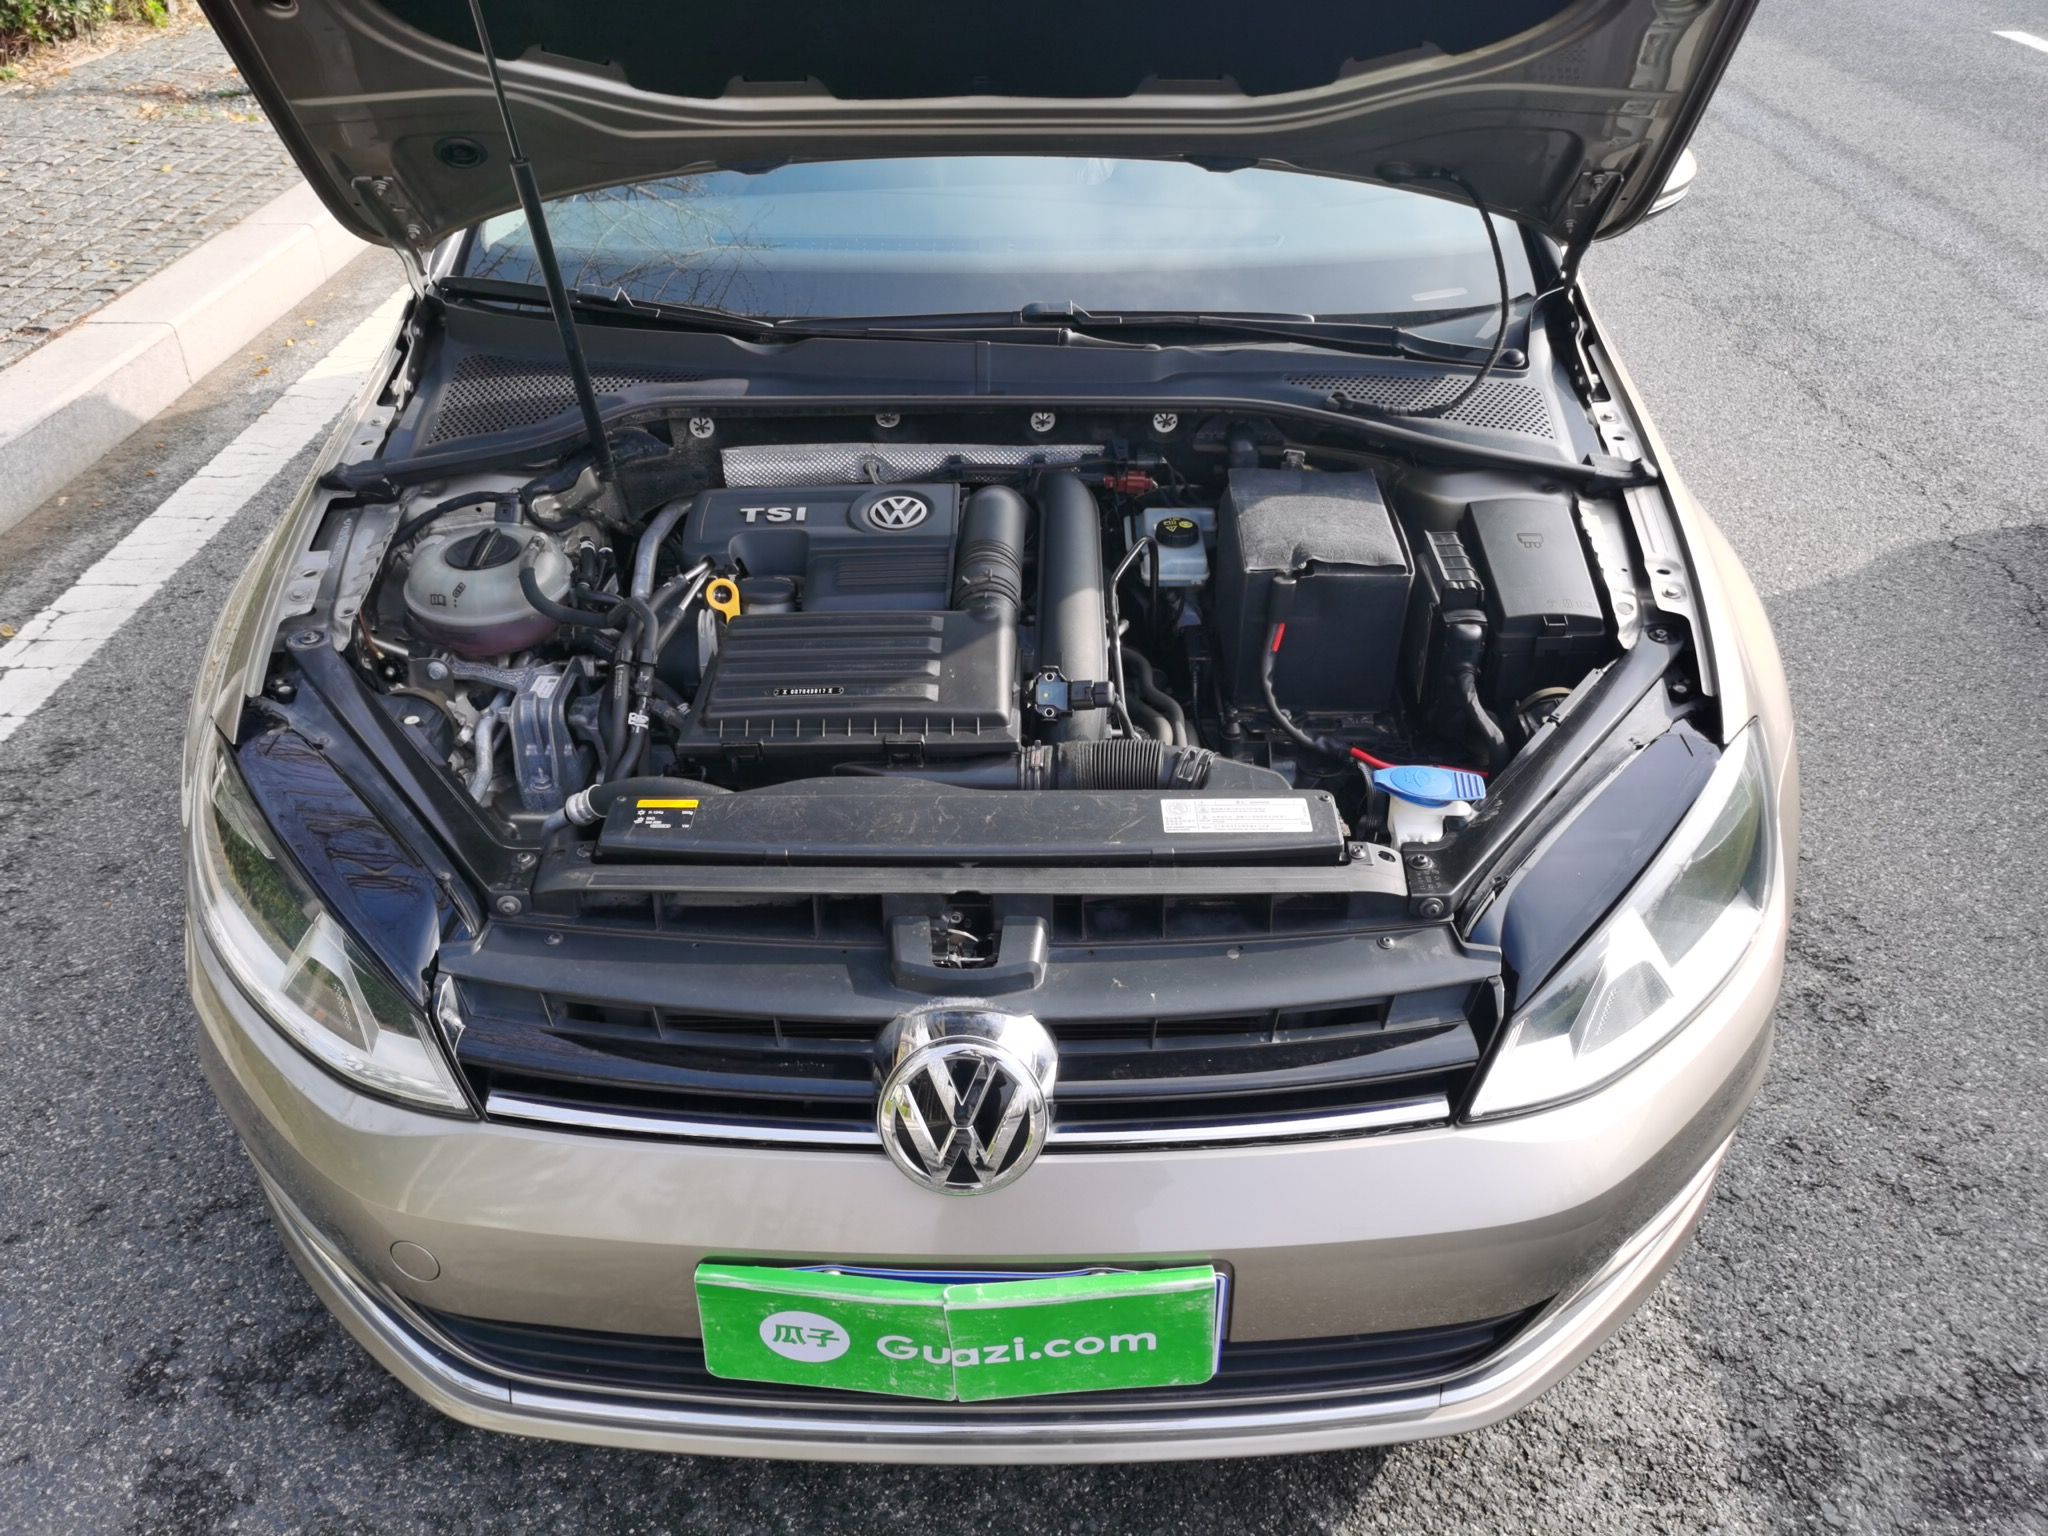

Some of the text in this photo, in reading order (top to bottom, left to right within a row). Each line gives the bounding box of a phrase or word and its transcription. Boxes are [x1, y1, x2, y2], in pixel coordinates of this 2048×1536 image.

[740, 506, 807, 523] TSI
[772, 1323, 841, 1348] 瓜子
[876, 1331, 1157, 1368] Guazi.com
